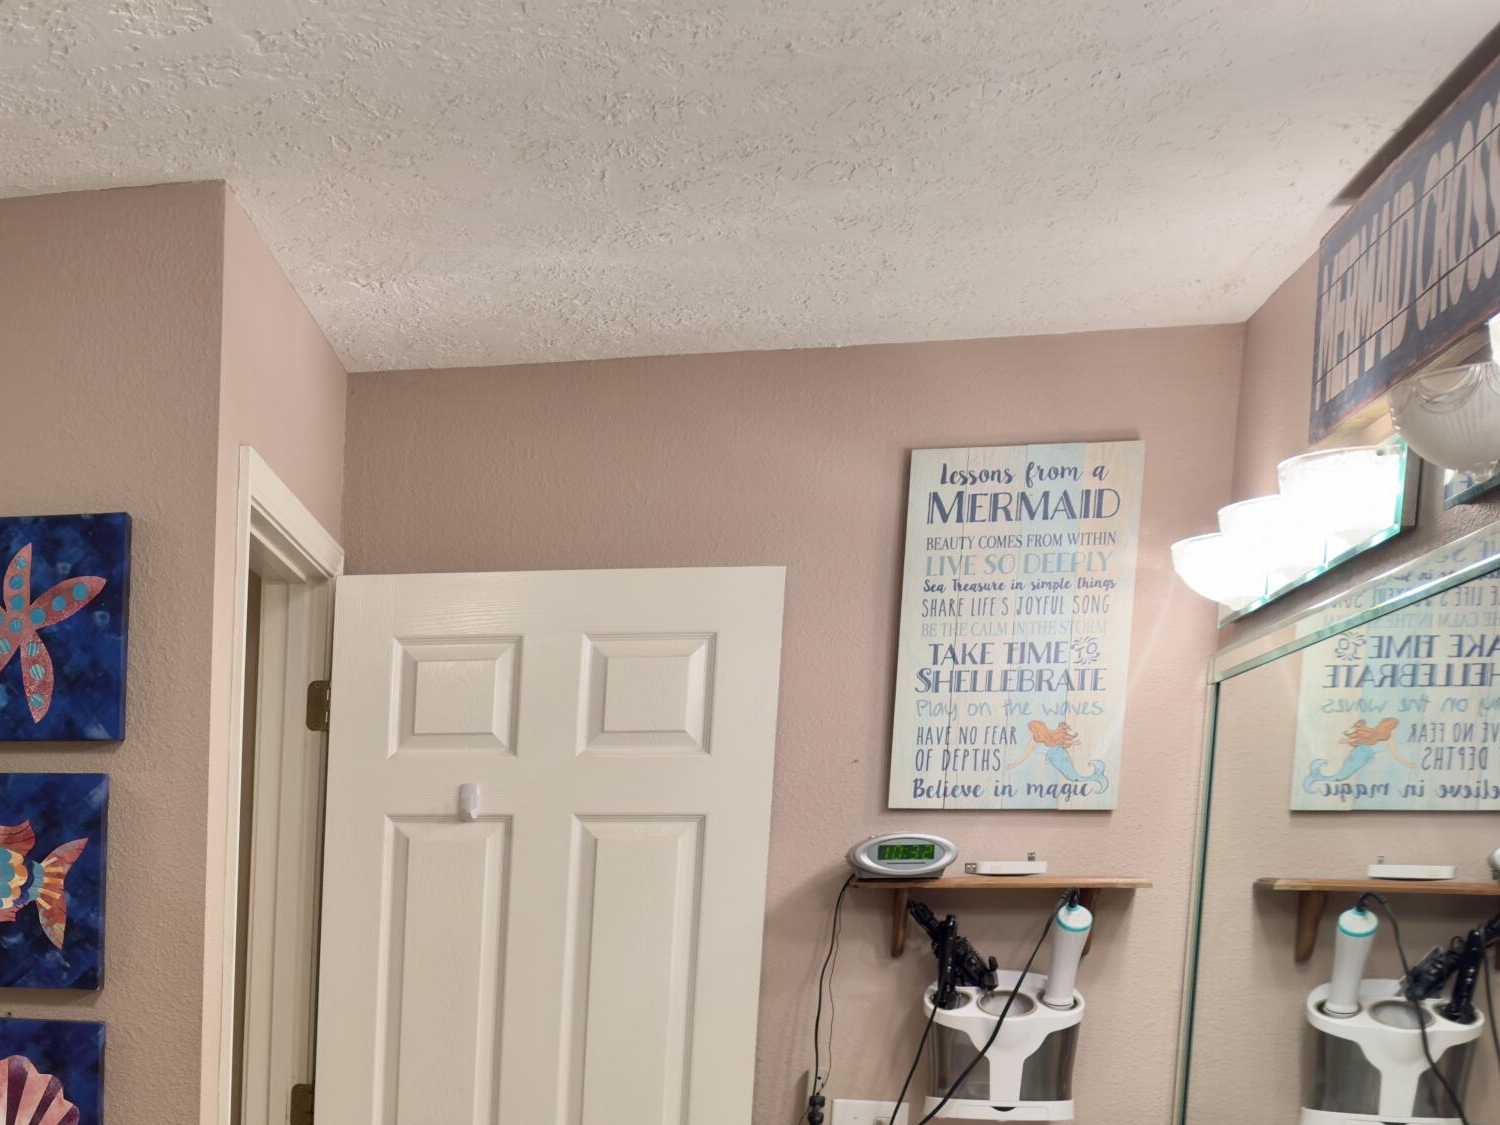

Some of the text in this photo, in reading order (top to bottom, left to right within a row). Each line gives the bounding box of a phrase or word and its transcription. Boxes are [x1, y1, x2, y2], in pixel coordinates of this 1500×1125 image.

[1315, 180, 1414, 411] MERMAID
[1026, 461, 1083, 488] from
[1092, 465, 1109, 481] a
[927, 488, 1121, 525] MERMAID
[927, 531, 1116, 550] BEAUTY COMES FROM WITHIN
[926, 551, 1114, 576] LIVE SO DEEPLY
[923, 576, 1118, 593] Sea Treasure in simple things
[921, 598, 964, 618] SHARE
[1016, 596, 1065, 616] JOYFUL
[1071, 594, 1111, 615] SONG
[921, 623, 938, 637] BE
[940, 623, 964, 637] THE
[970, 622, 1008, 637] CALM
[1011, 621, 1025, 636] IN
[1026, 621, 1058, 636] THE
[928, 643, 995, 666] TAKE
[1003, 641, 1070, 665] TIME
[915, 667, 1108, 693] SHELLEBRATE
[916, 698, 1105, 720] Play on the waves
[916, 726, 1018, 745] HAVE NO FEAR
[915, 748, 1001, 771] OF DEPTHS
[912, 778, 1094, 802] Believe in magic
